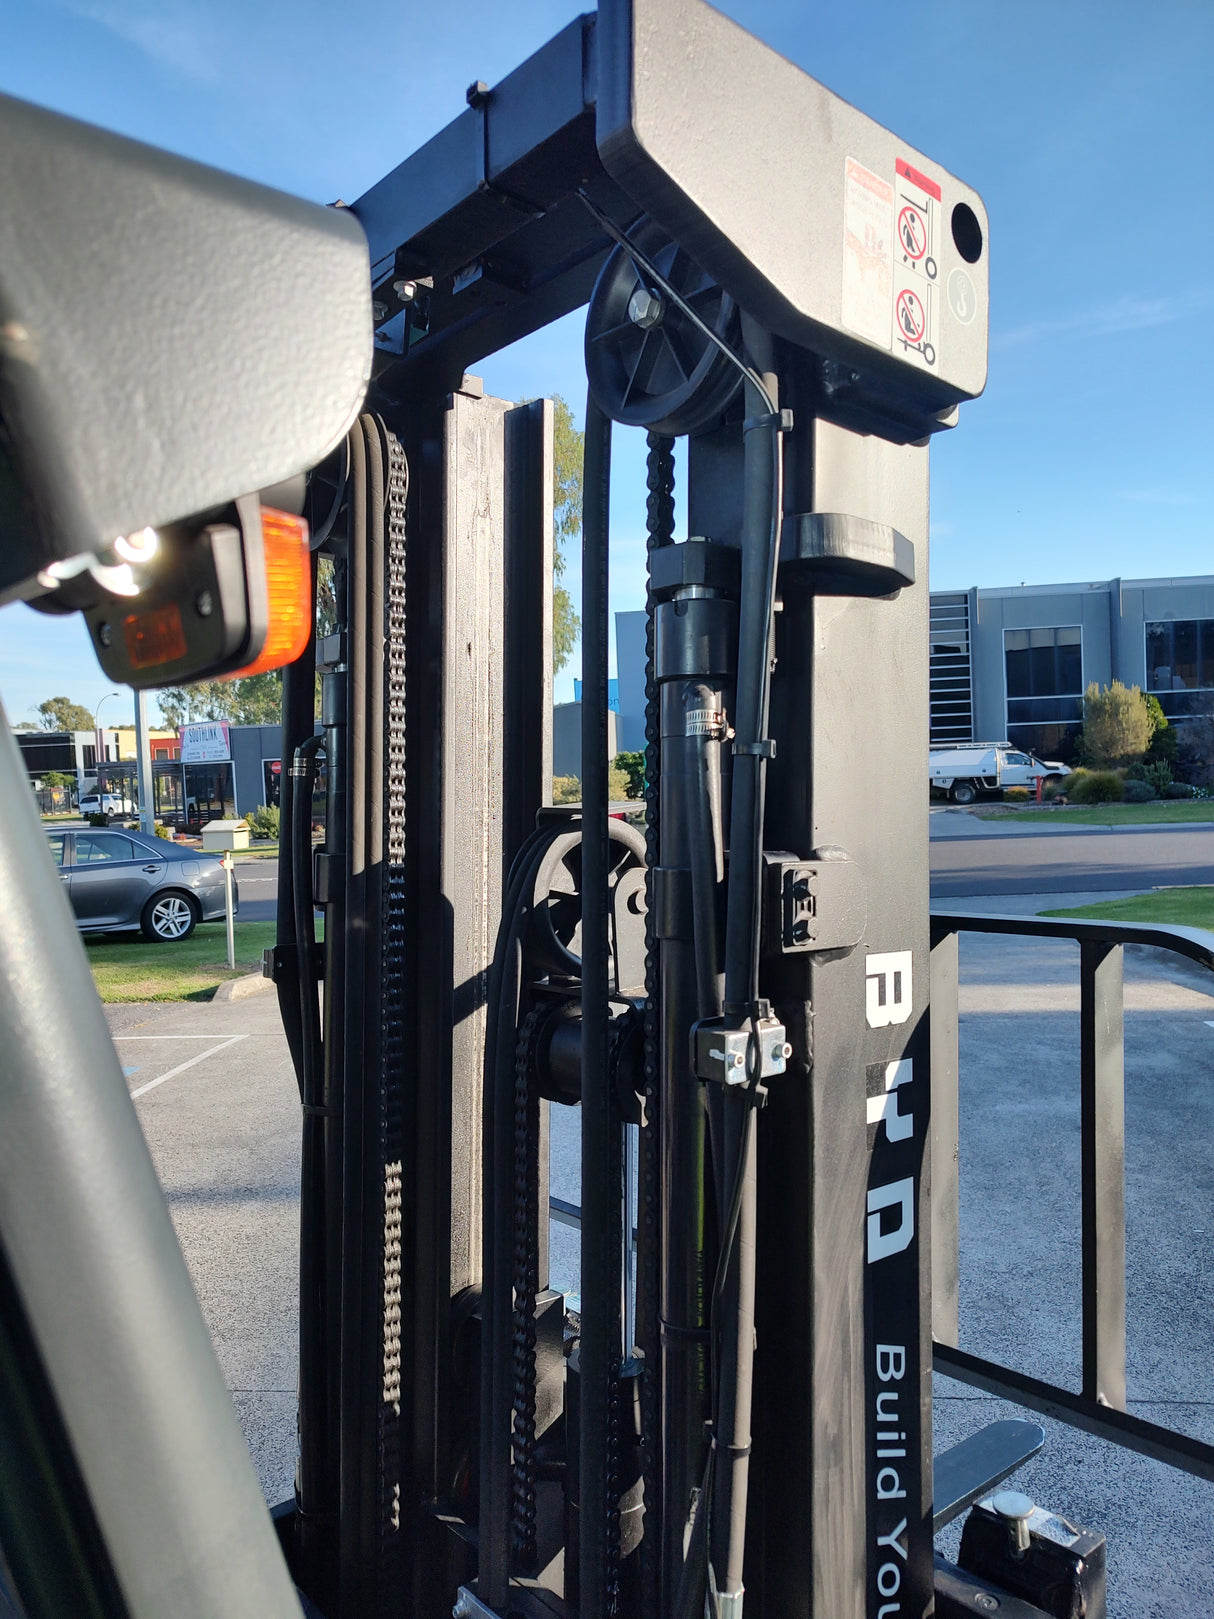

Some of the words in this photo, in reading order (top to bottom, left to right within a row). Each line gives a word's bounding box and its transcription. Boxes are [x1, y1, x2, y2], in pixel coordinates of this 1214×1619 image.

[188, 726, 217, 742] SOUTHLINK
[865, 950, 914, 1264] BYD
[876, 1344, 906, 1499] Build
